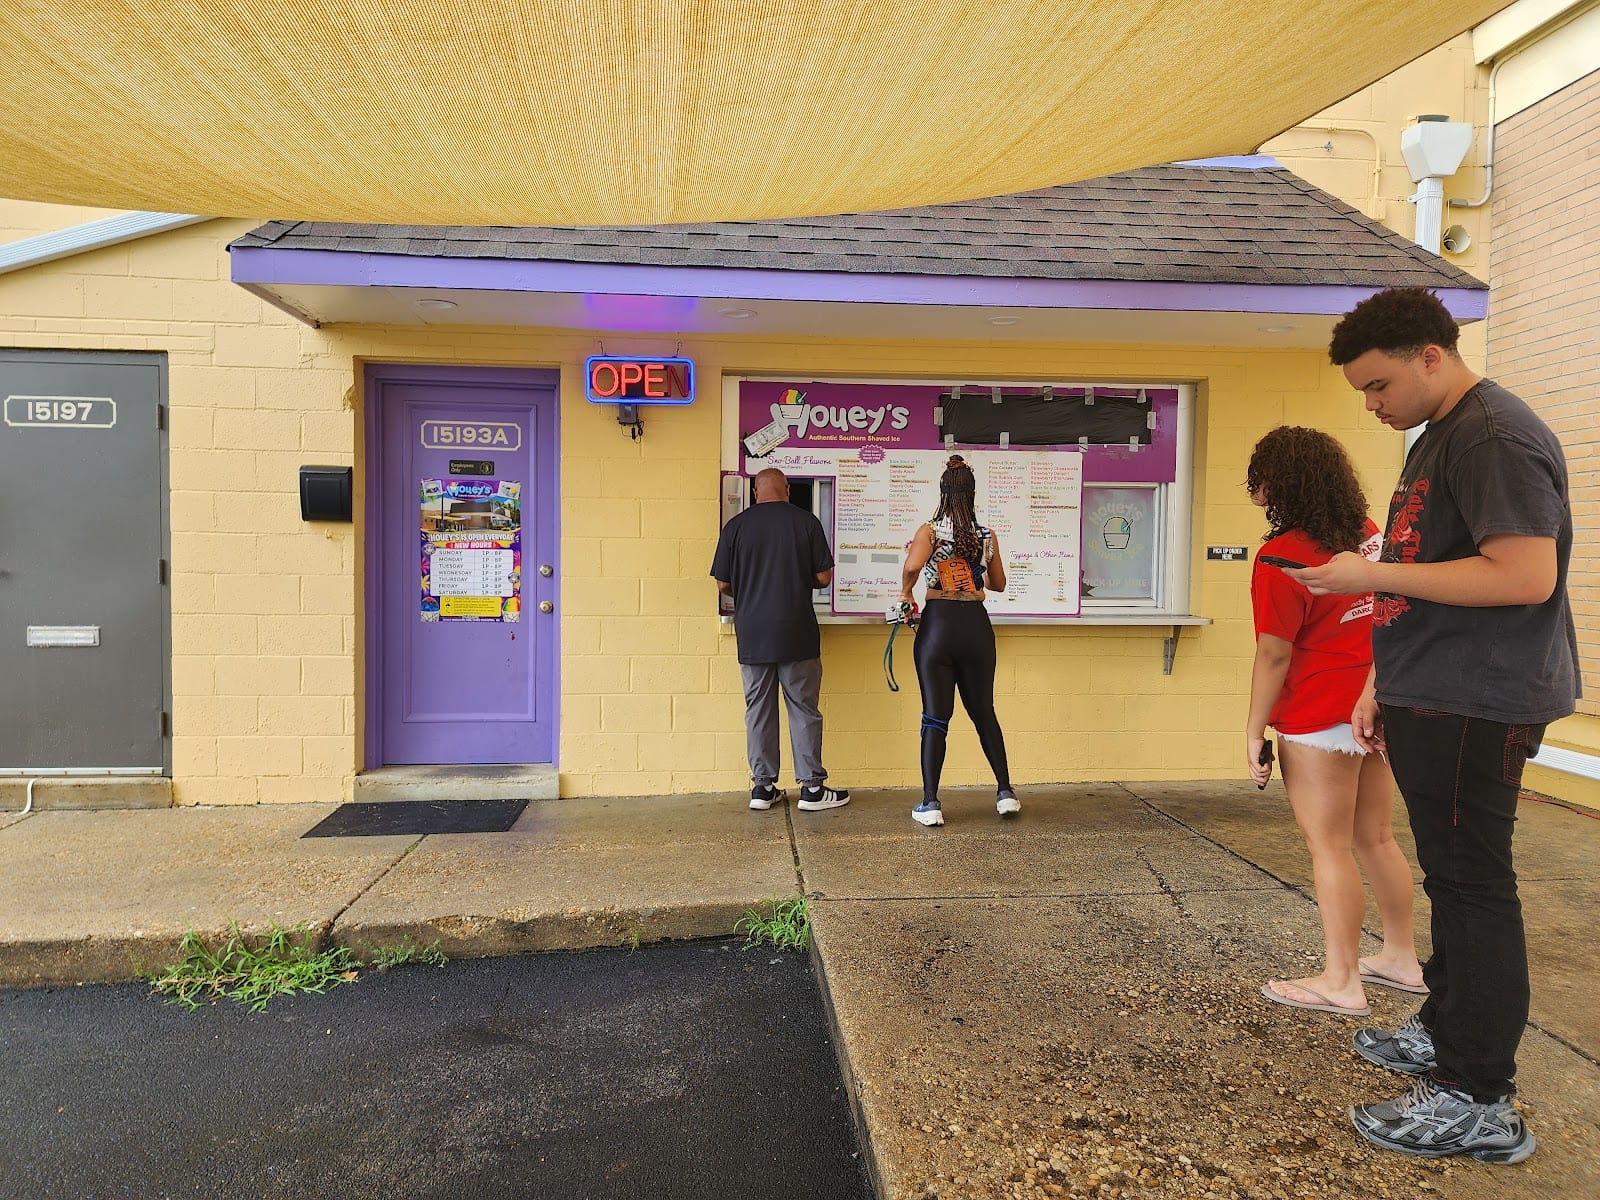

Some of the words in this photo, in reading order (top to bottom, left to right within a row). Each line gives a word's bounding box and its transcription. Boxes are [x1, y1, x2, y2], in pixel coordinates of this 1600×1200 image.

[592, 363, 689, 397] OPEN
[28, 401, 93, 421] 15197
[769, 403, 910, 439] Houey's
[433, 426, 509, 445] 15193A
[802, 456, 832, 465] Flavors
[447, 485, 490, 496] Houey's
[1088, 502, 1143, 527] Houey's
[1010, 551, 1033, 560] Toppings
[1361, 541, 1380, 558] ARS
